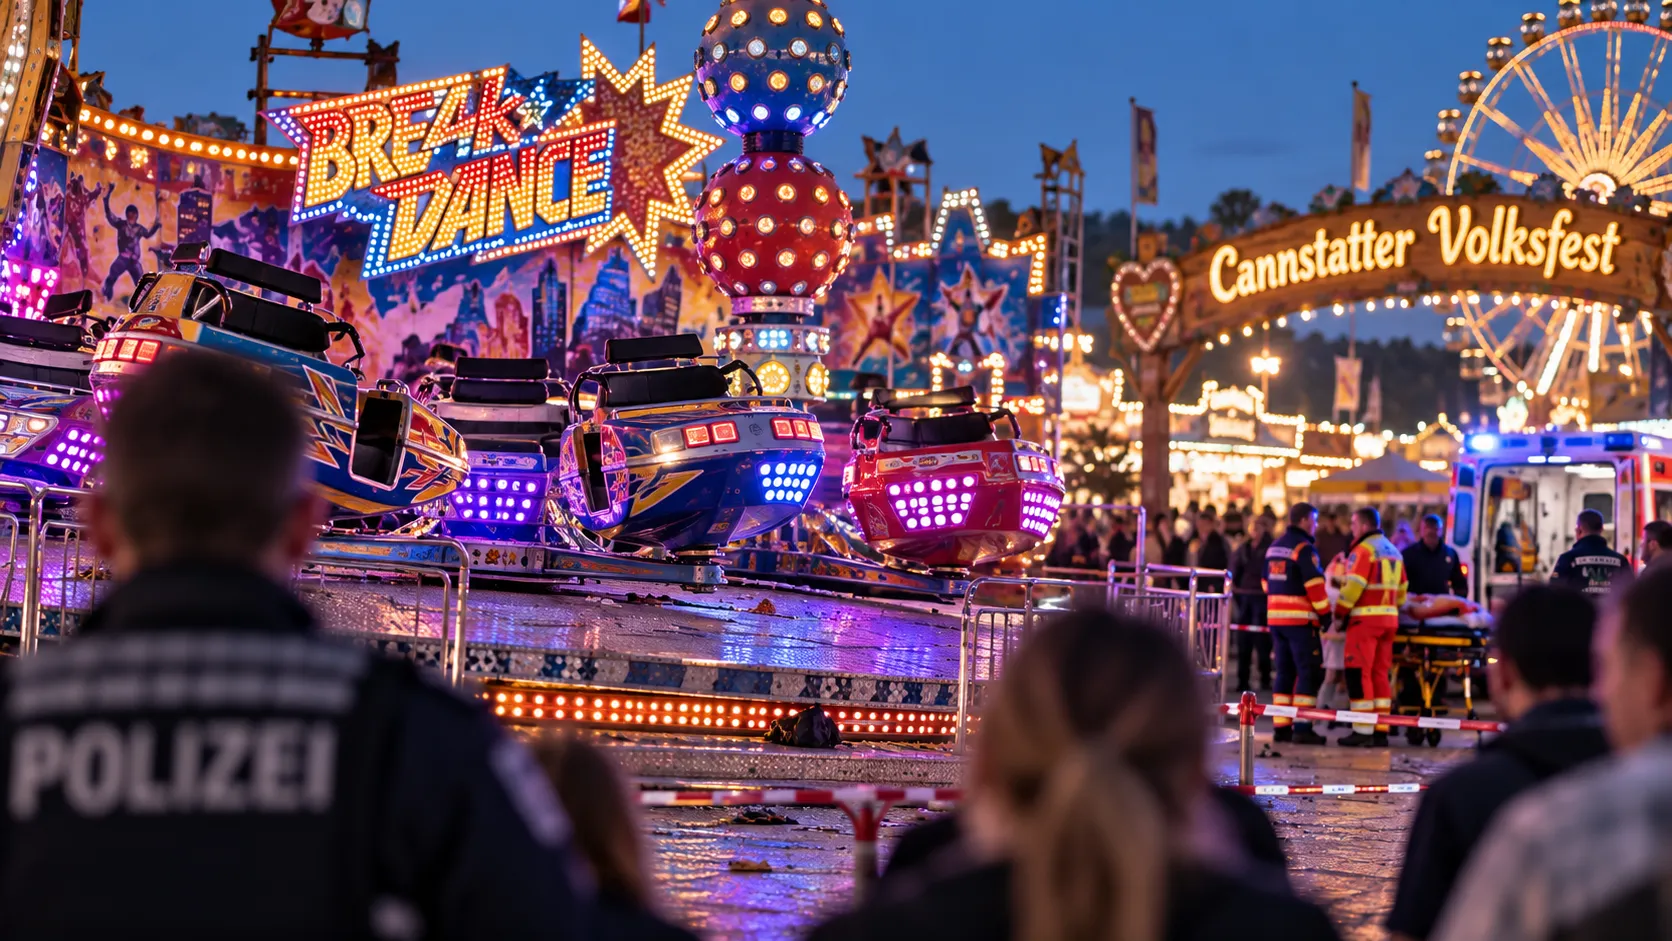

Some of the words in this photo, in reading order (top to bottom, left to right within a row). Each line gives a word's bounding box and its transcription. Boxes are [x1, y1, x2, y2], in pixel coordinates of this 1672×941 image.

[301, 76, 526, 208] BREAK
[371, 132, 607, 261] DANCE
[1209, 219, 1416, 303] Cannstatter
[1427, 204, 1621, 279] Volksfest
[12, 719, 336, 819] POLIZEI
